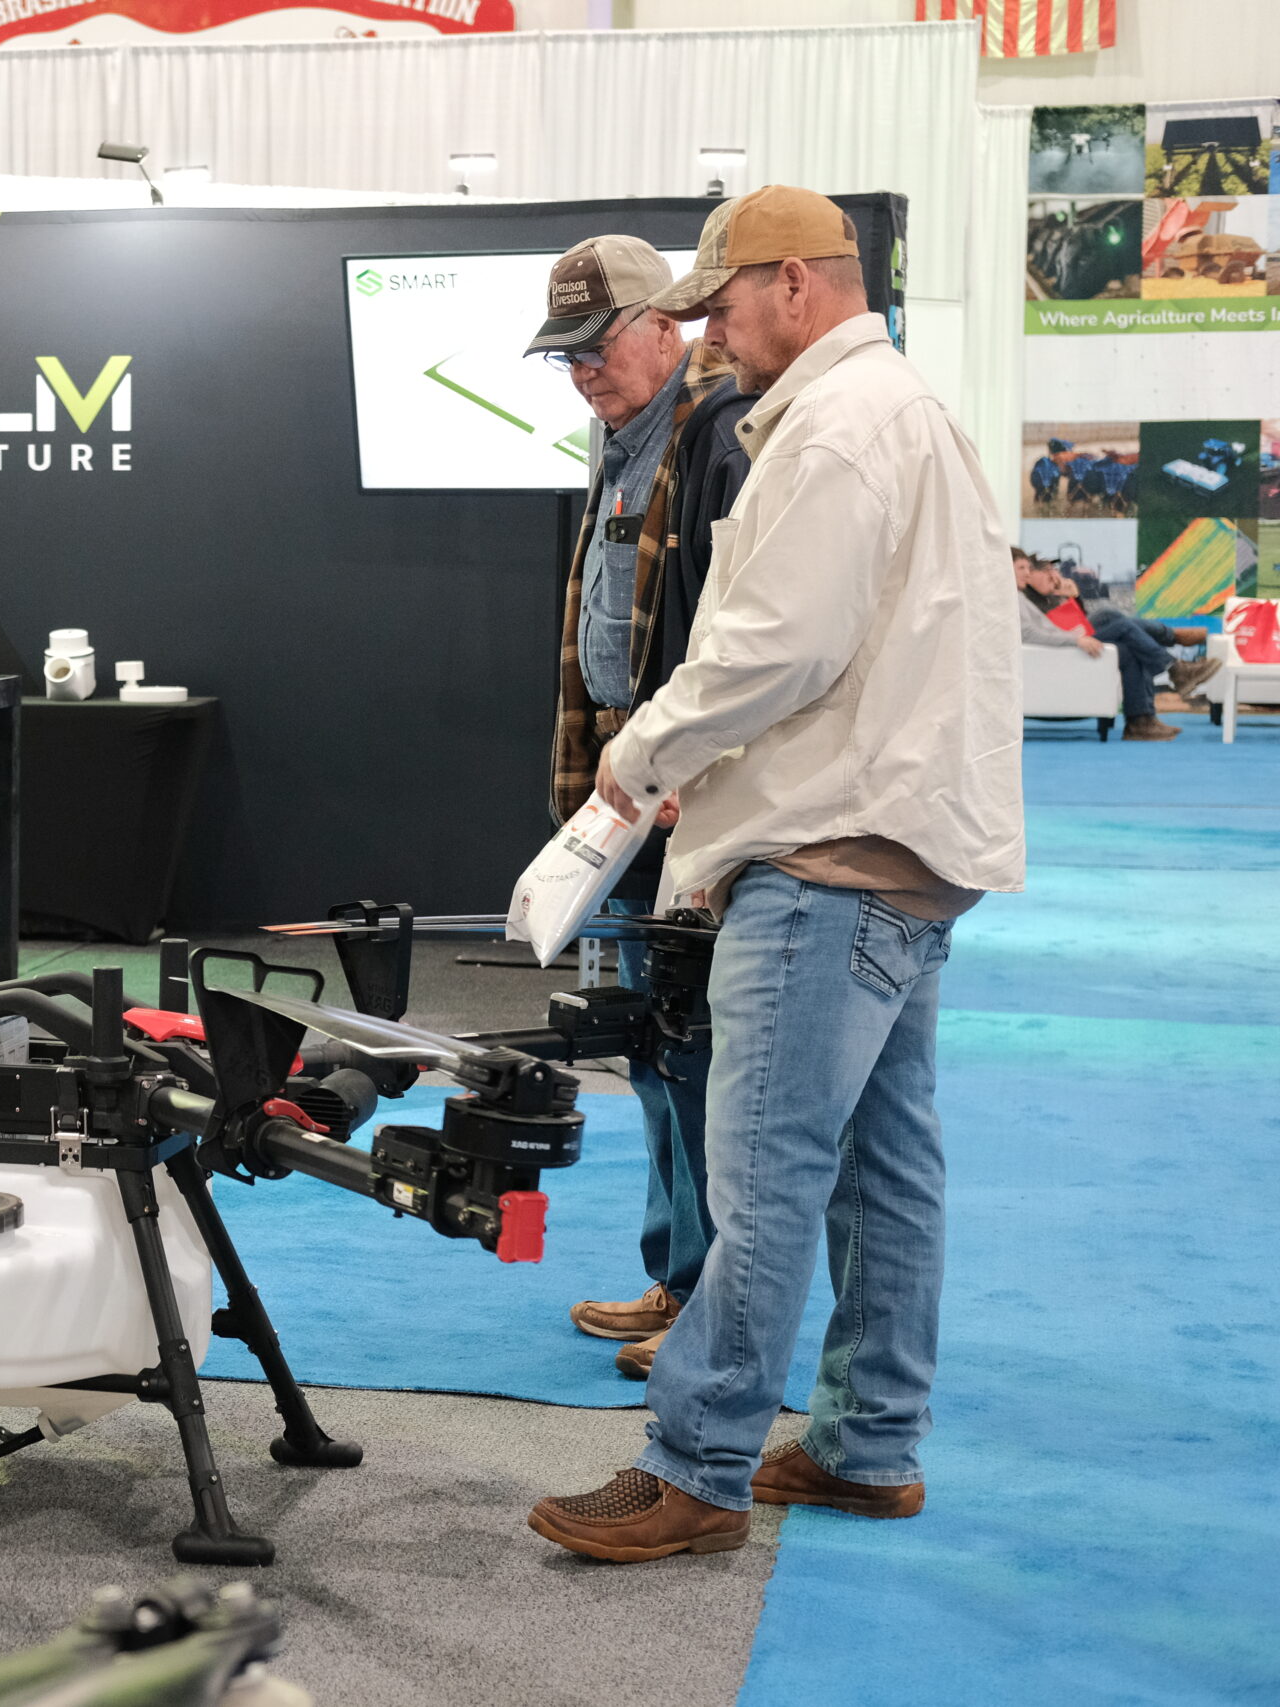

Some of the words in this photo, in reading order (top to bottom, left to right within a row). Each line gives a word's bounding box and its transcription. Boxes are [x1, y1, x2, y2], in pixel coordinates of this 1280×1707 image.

[389, 273, 459, 290] SMART
[552, 280, 587, 295] Denison
[552, 290, 591, 308] Livestock
[1039, 311, 1097, 327] Where
[1103, 309, 1205, 328] Agriculture
[1210, 307, 1265, 323] Meets
